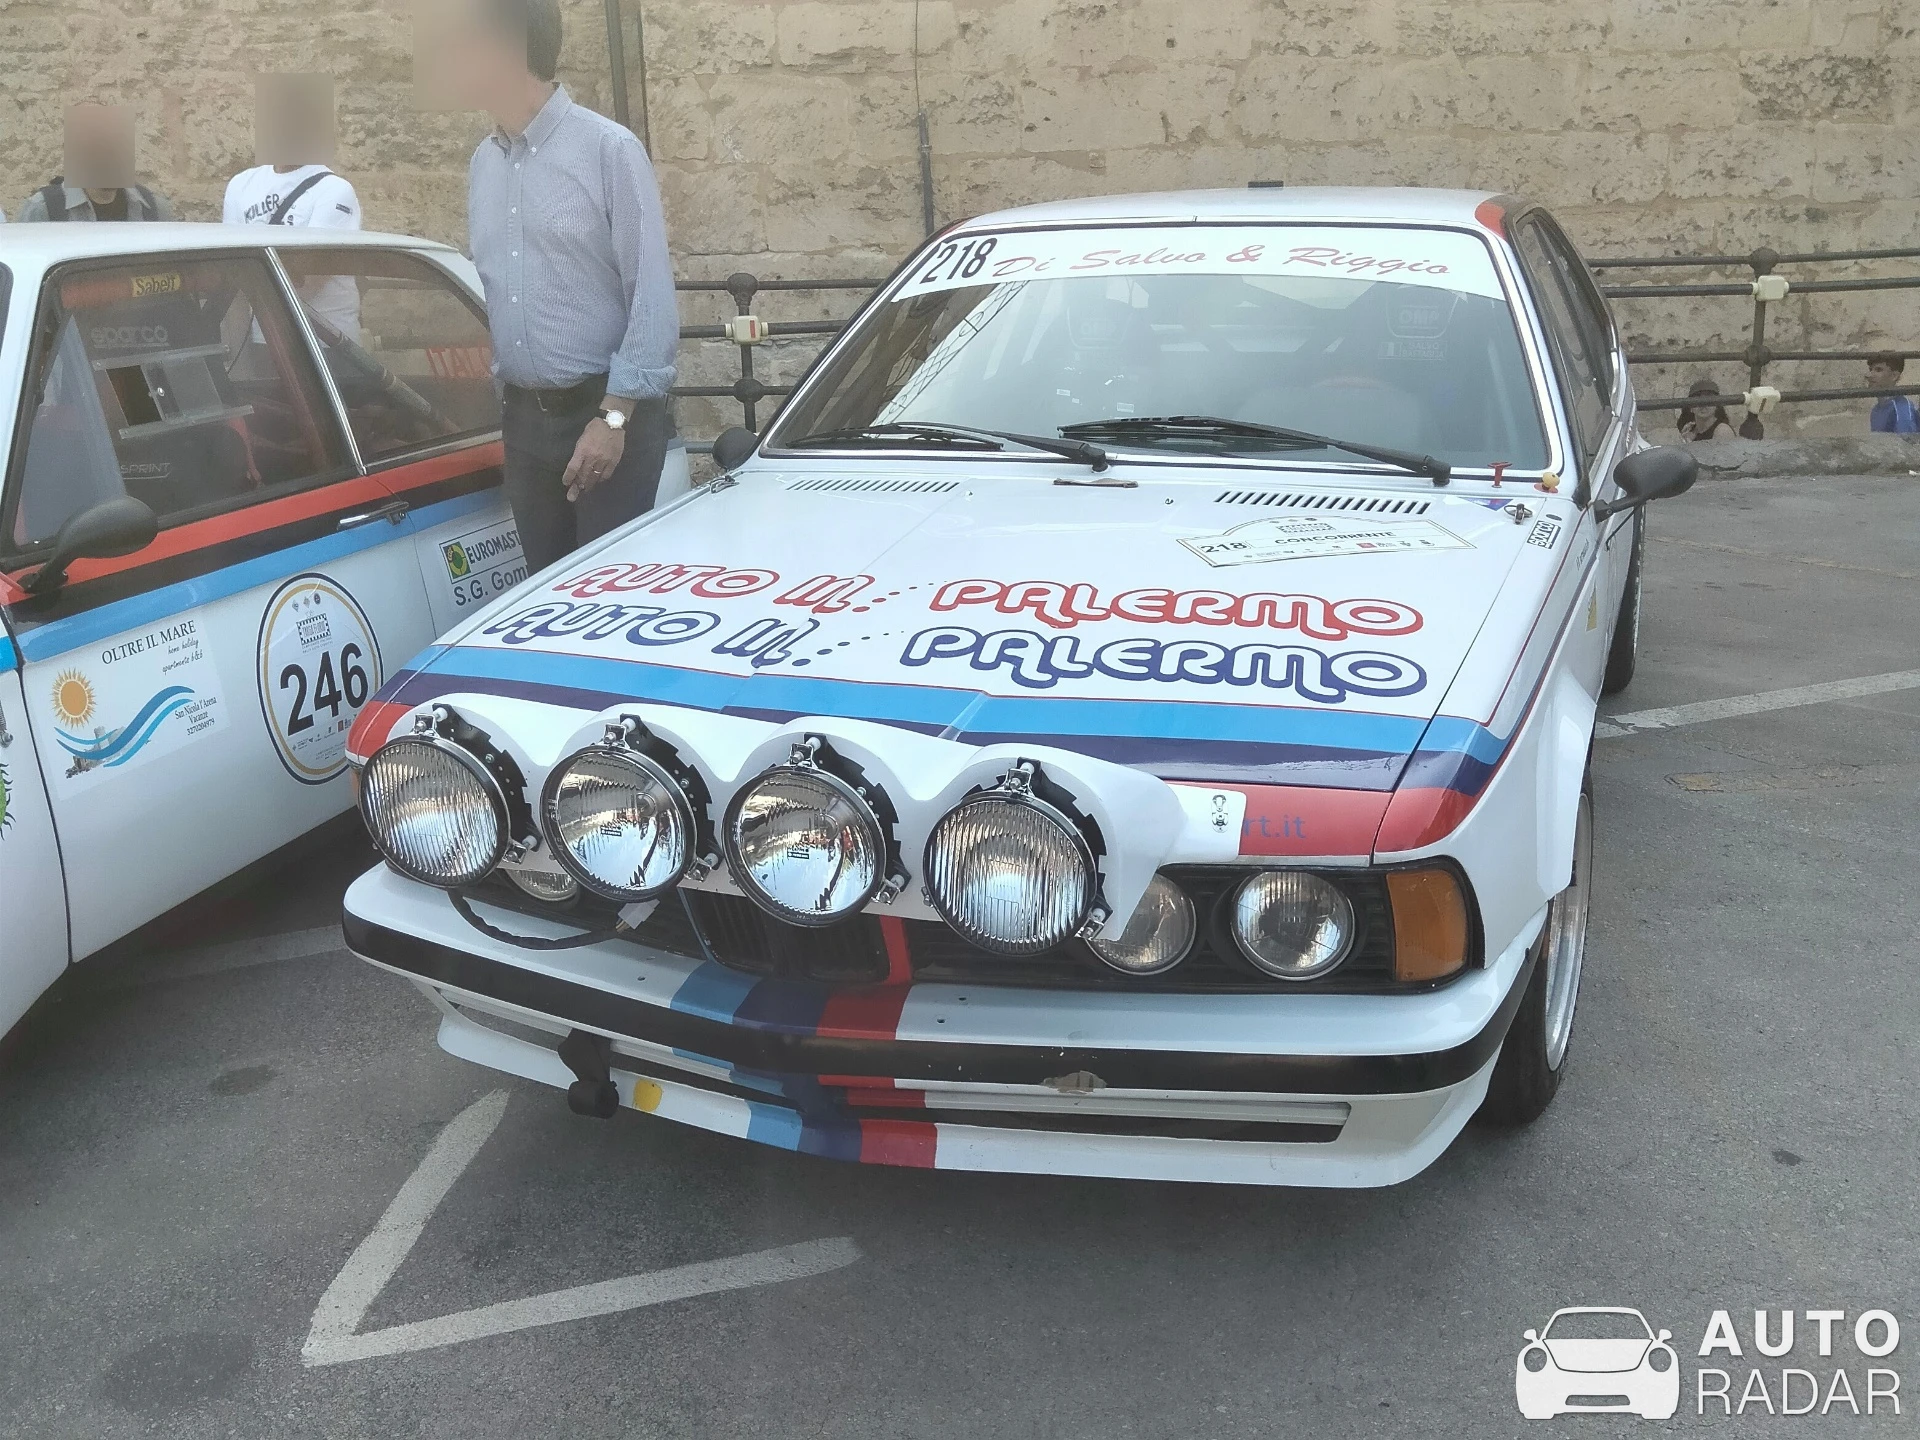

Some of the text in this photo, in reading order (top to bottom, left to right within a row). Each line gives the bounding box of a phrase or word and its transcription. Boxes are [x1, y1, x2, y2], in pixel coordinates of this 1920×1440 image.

[244, 193, 280, 223] KILLER
[919, 237, 998, 284] 218
[992, 244, 1450, 278] Di Salvo & Riggio
[120, 462, 171, 474] SPRINT
[1199, 541, 1247, 553] 218
[1275, 531, 1393, 545] CONCORRENTE
[453, 579, 489, 606] S.G.
[552, 563, 780, 598] AUTO
[929, 578, 1424, 642] PALERMO
[101, 619, 196, 665] OLTRE IL MARE
[482, 602, 722, 646] AUTO
[899, 626, 1428, 704] PALERMO
[280, 642, 369, 737] 246
